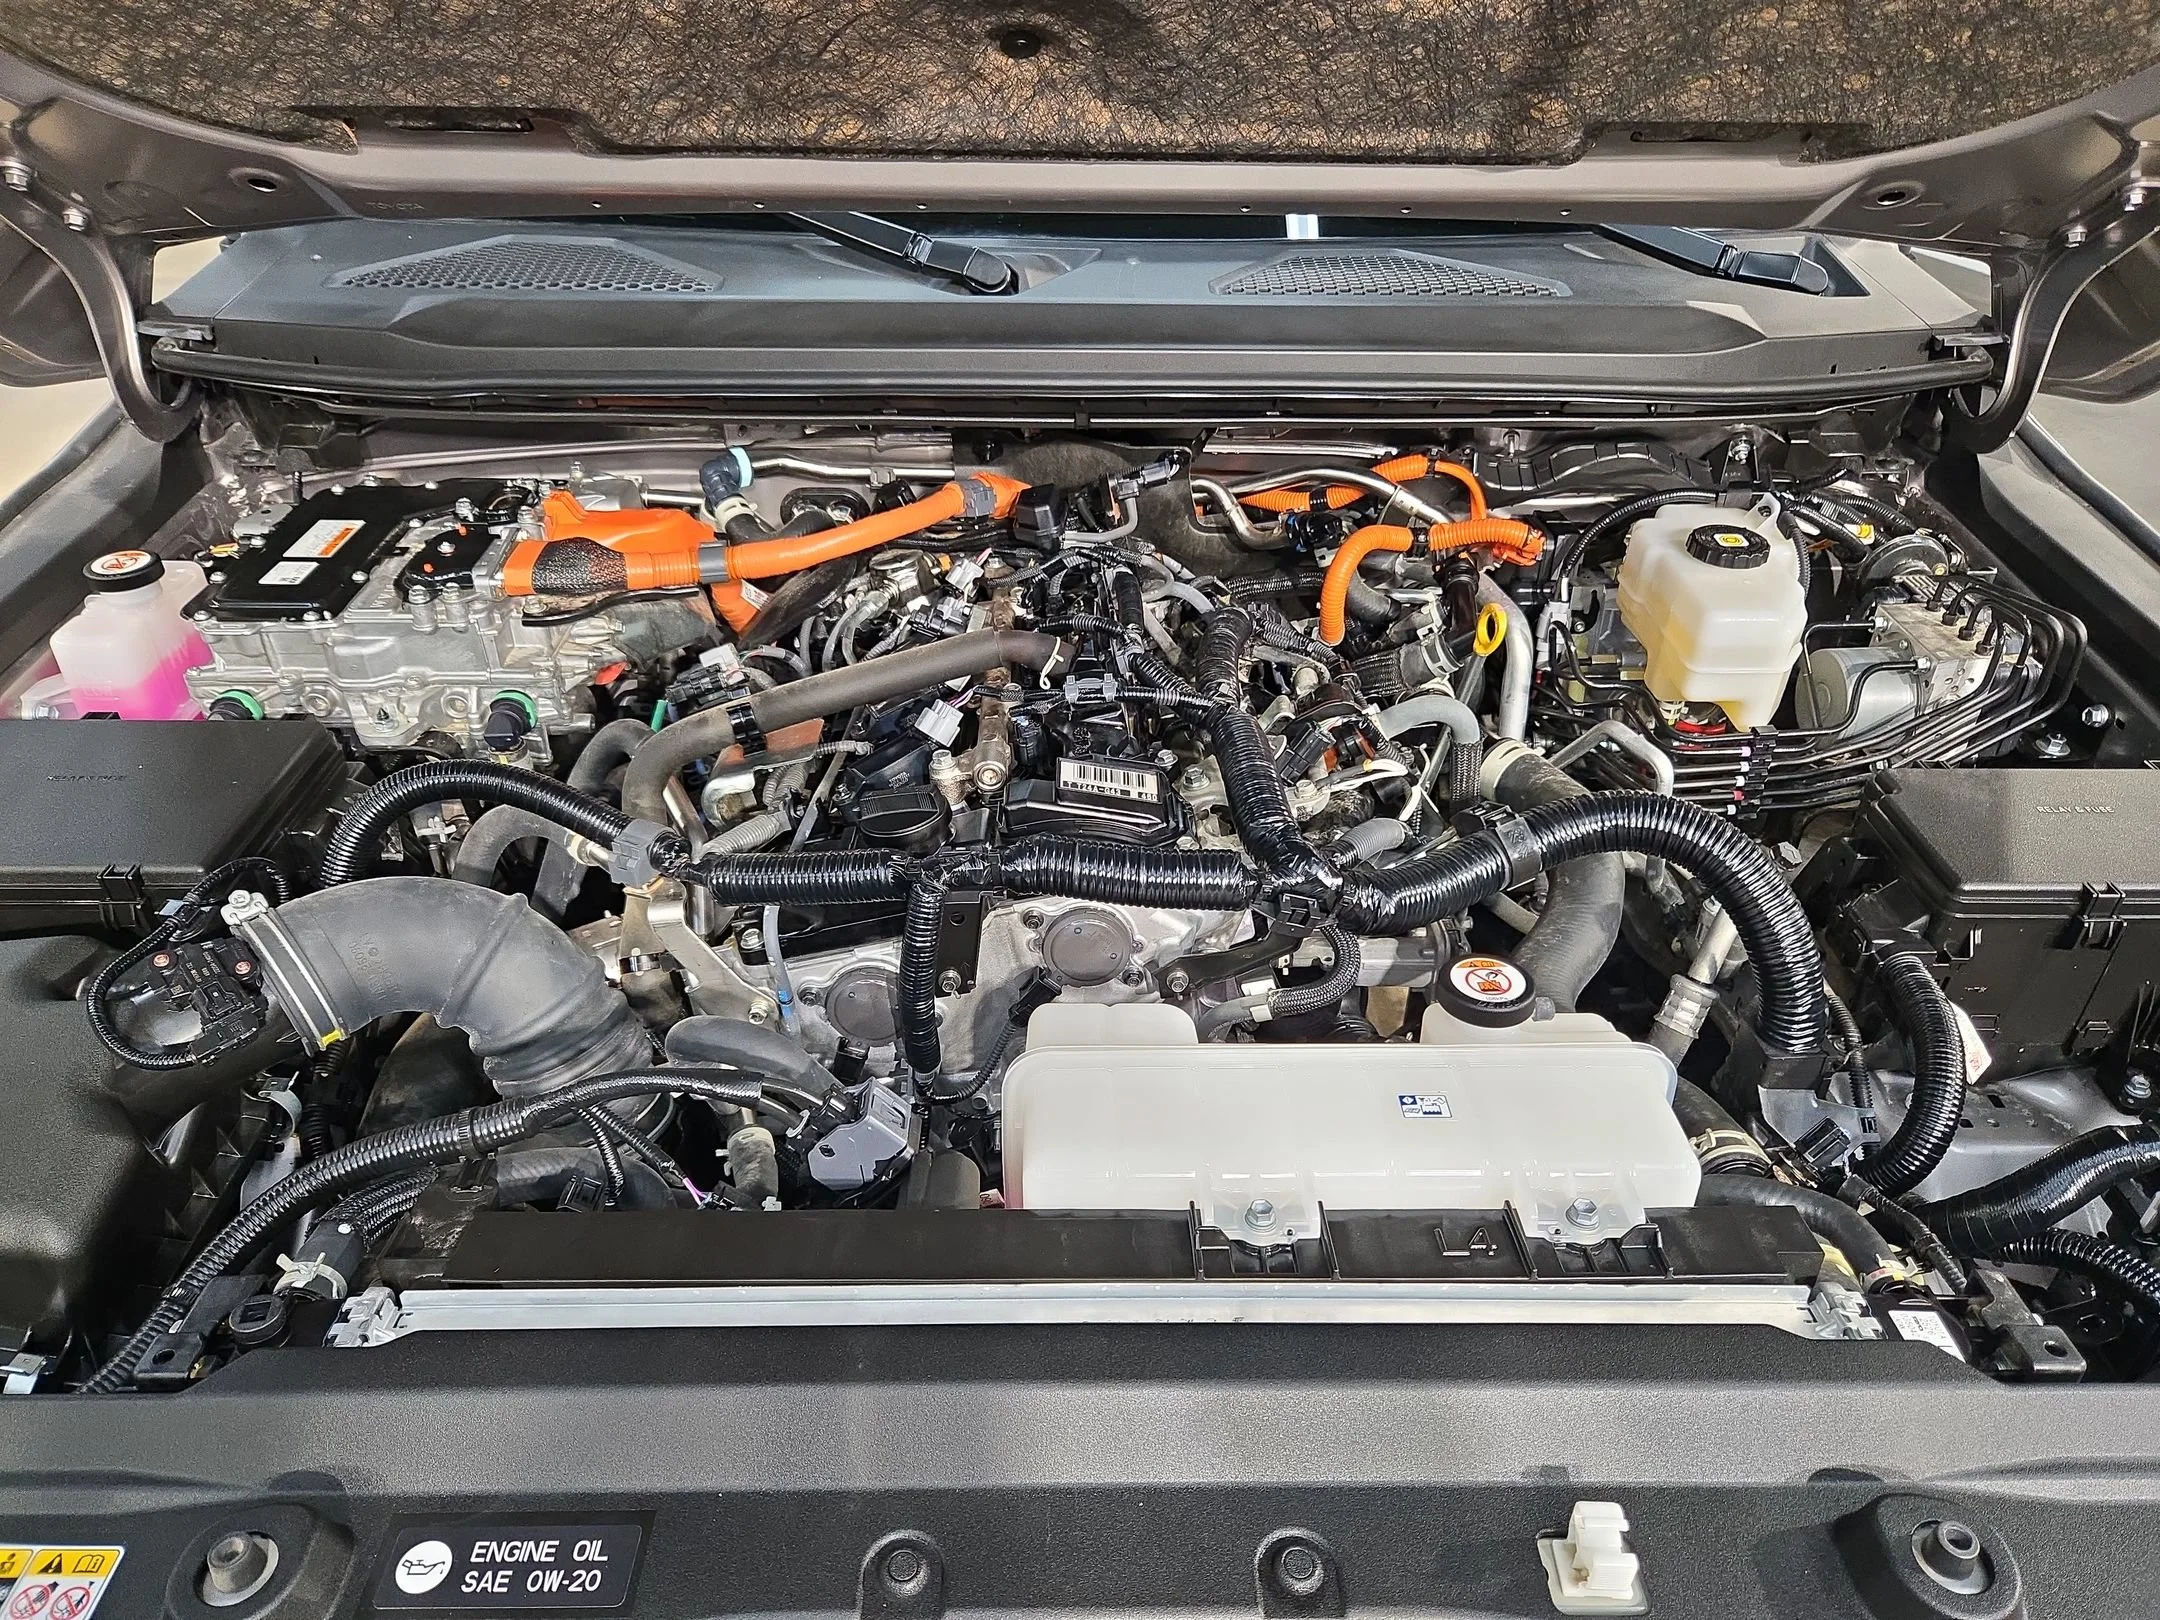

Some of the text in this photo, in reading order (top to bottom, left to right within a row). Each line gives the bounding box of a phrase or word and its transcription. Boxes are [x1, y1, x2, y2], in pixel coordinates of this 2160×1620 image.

[470, 1539, 609, 1563] ENGINE OIL
[460, 1569, 602, 1593] SAE 0W-20
